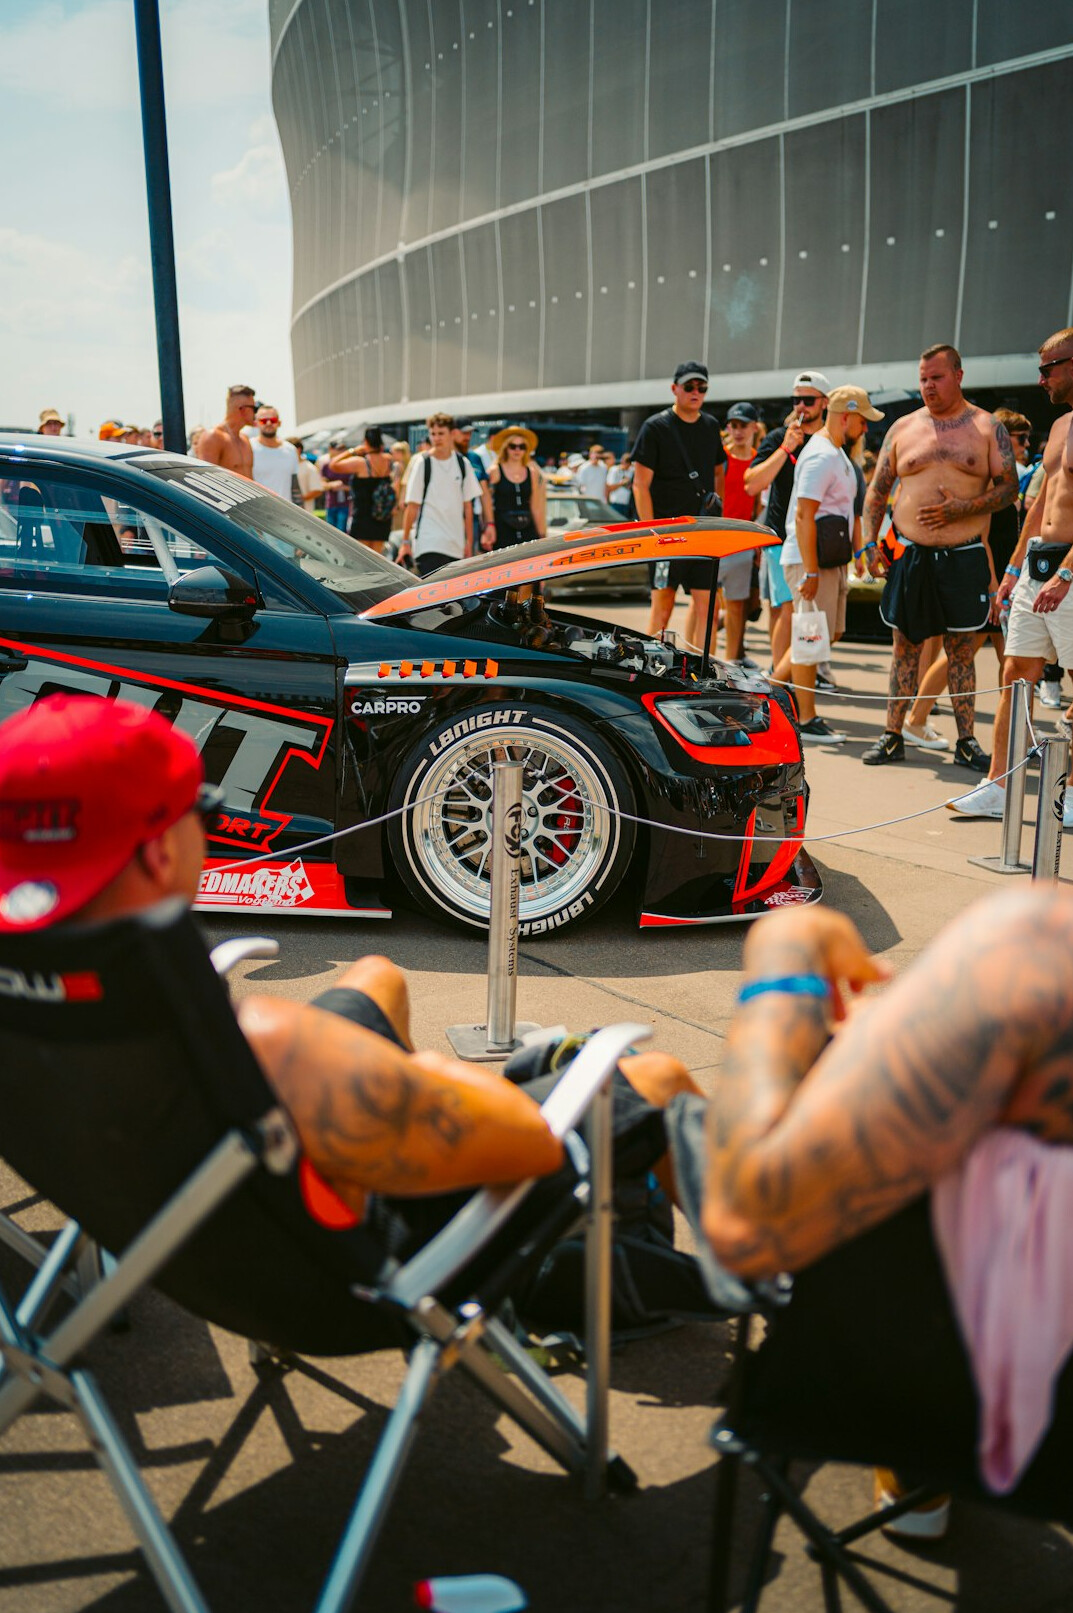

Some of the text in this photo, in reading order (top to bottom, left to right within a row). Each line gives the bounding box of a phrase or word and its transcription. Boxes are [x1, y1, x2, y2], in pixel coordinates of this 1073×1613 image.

[350, 701, 421, 714] CARPRO
[504, 807, 522, 852] FOX
[508, 868, 520, 977] Exhaust Systems
